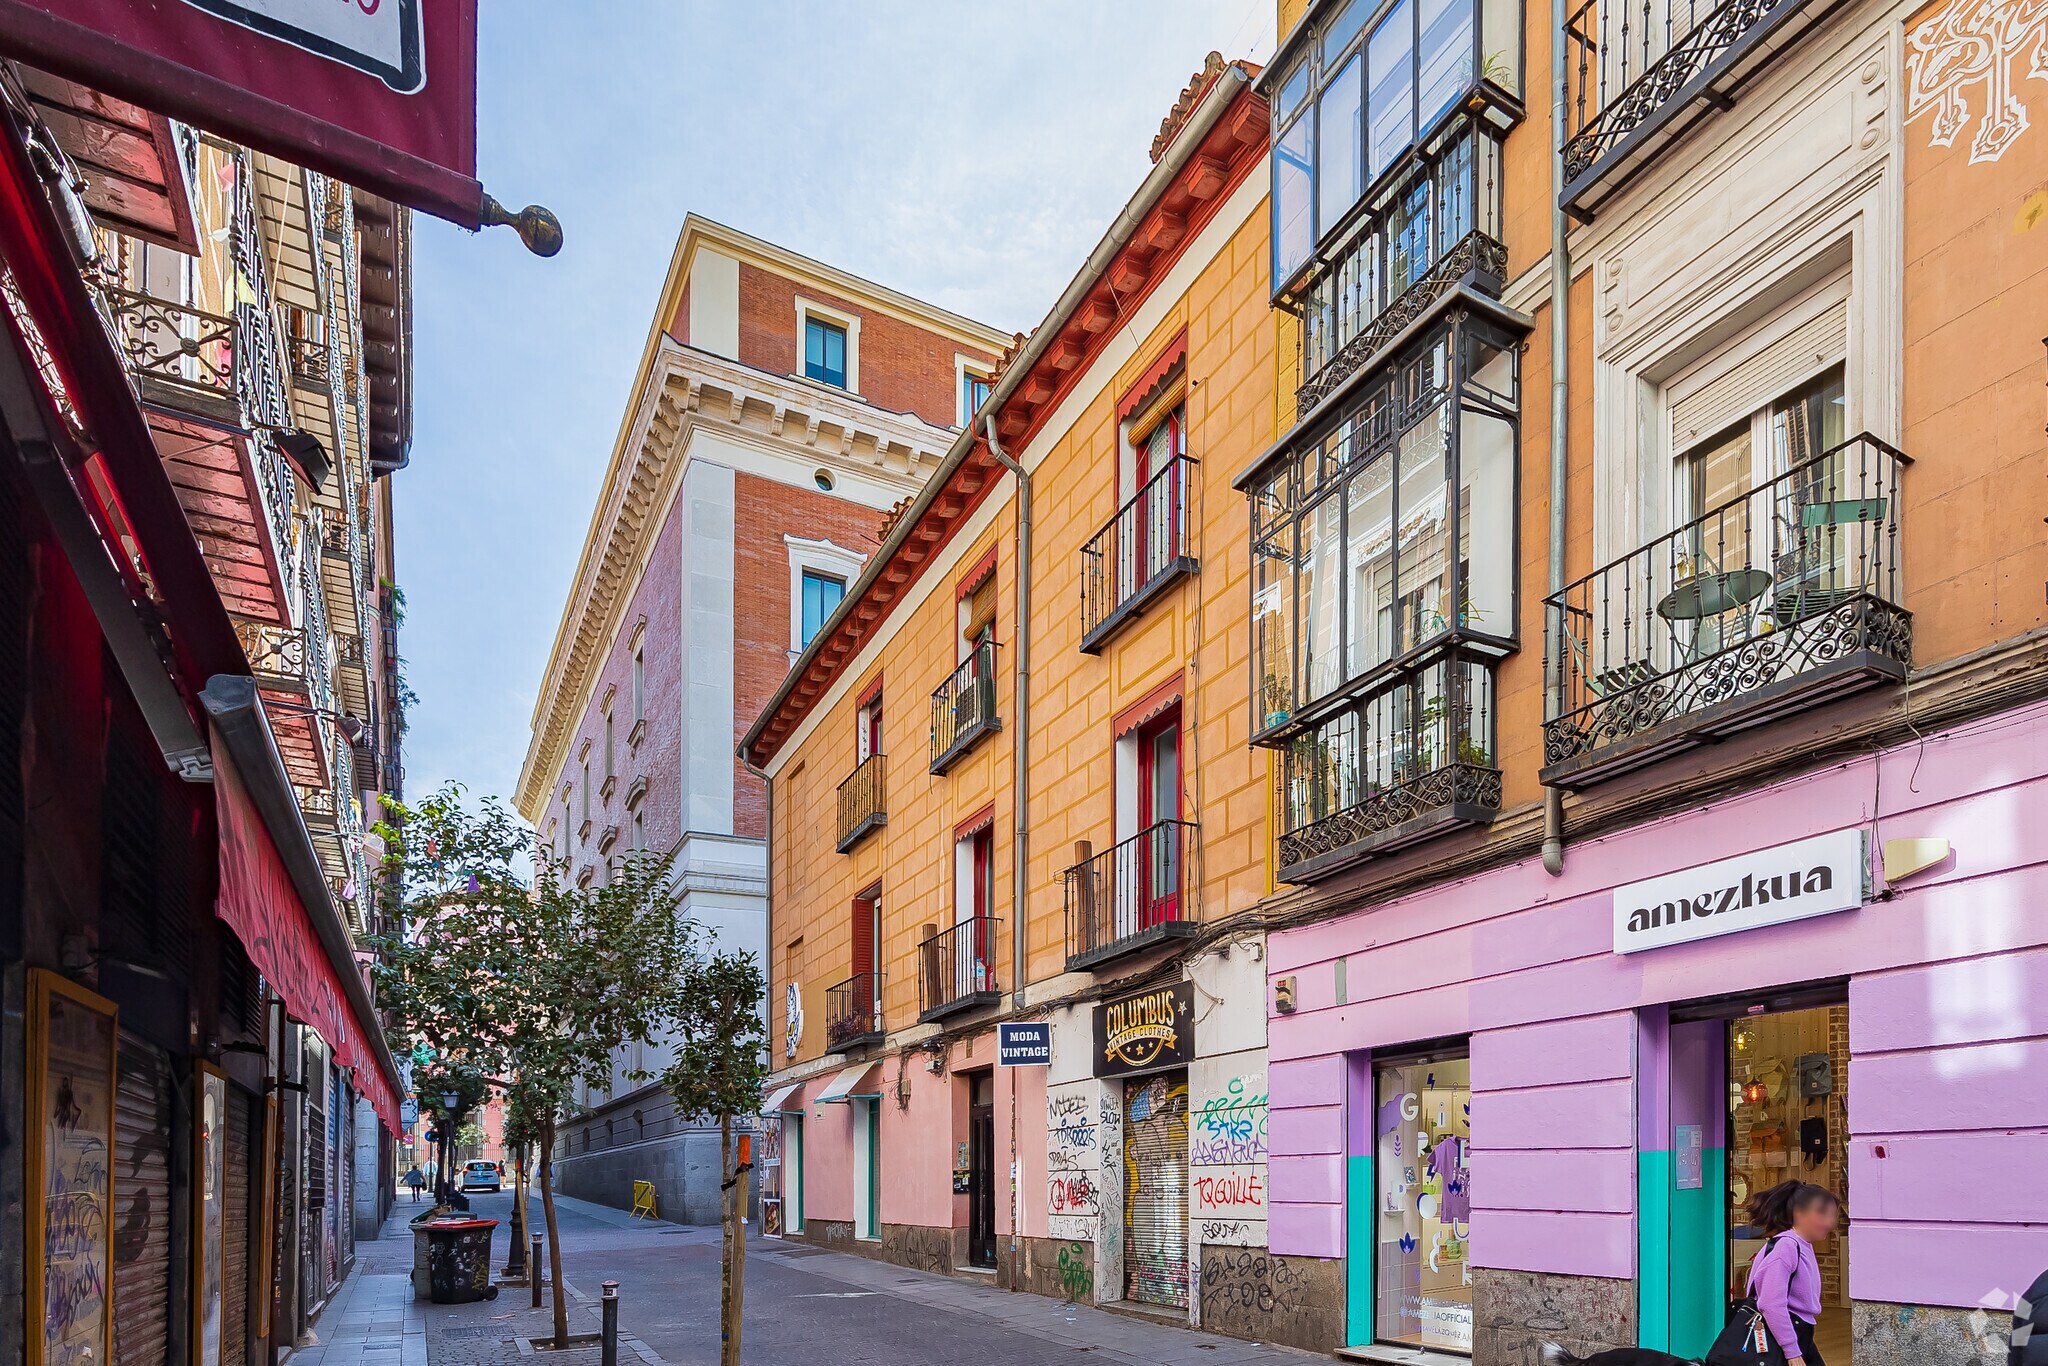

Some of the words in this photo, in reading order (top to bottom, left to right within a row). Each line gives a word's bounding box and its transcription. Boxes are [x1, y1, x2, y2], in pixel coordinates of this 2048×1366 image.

[1627, 865, 1833, 933] amezkua
[1107, 990, 1175, 1040] COLUMBUS
[1009, 1031, 1041, 1042] MODA
[1109, 1030, 1136, 1051] VINTAGE
[1140, 1026, 1171, 1039] CLOTHES
[1001, 1046, 1049, 1058] VINTAGE
